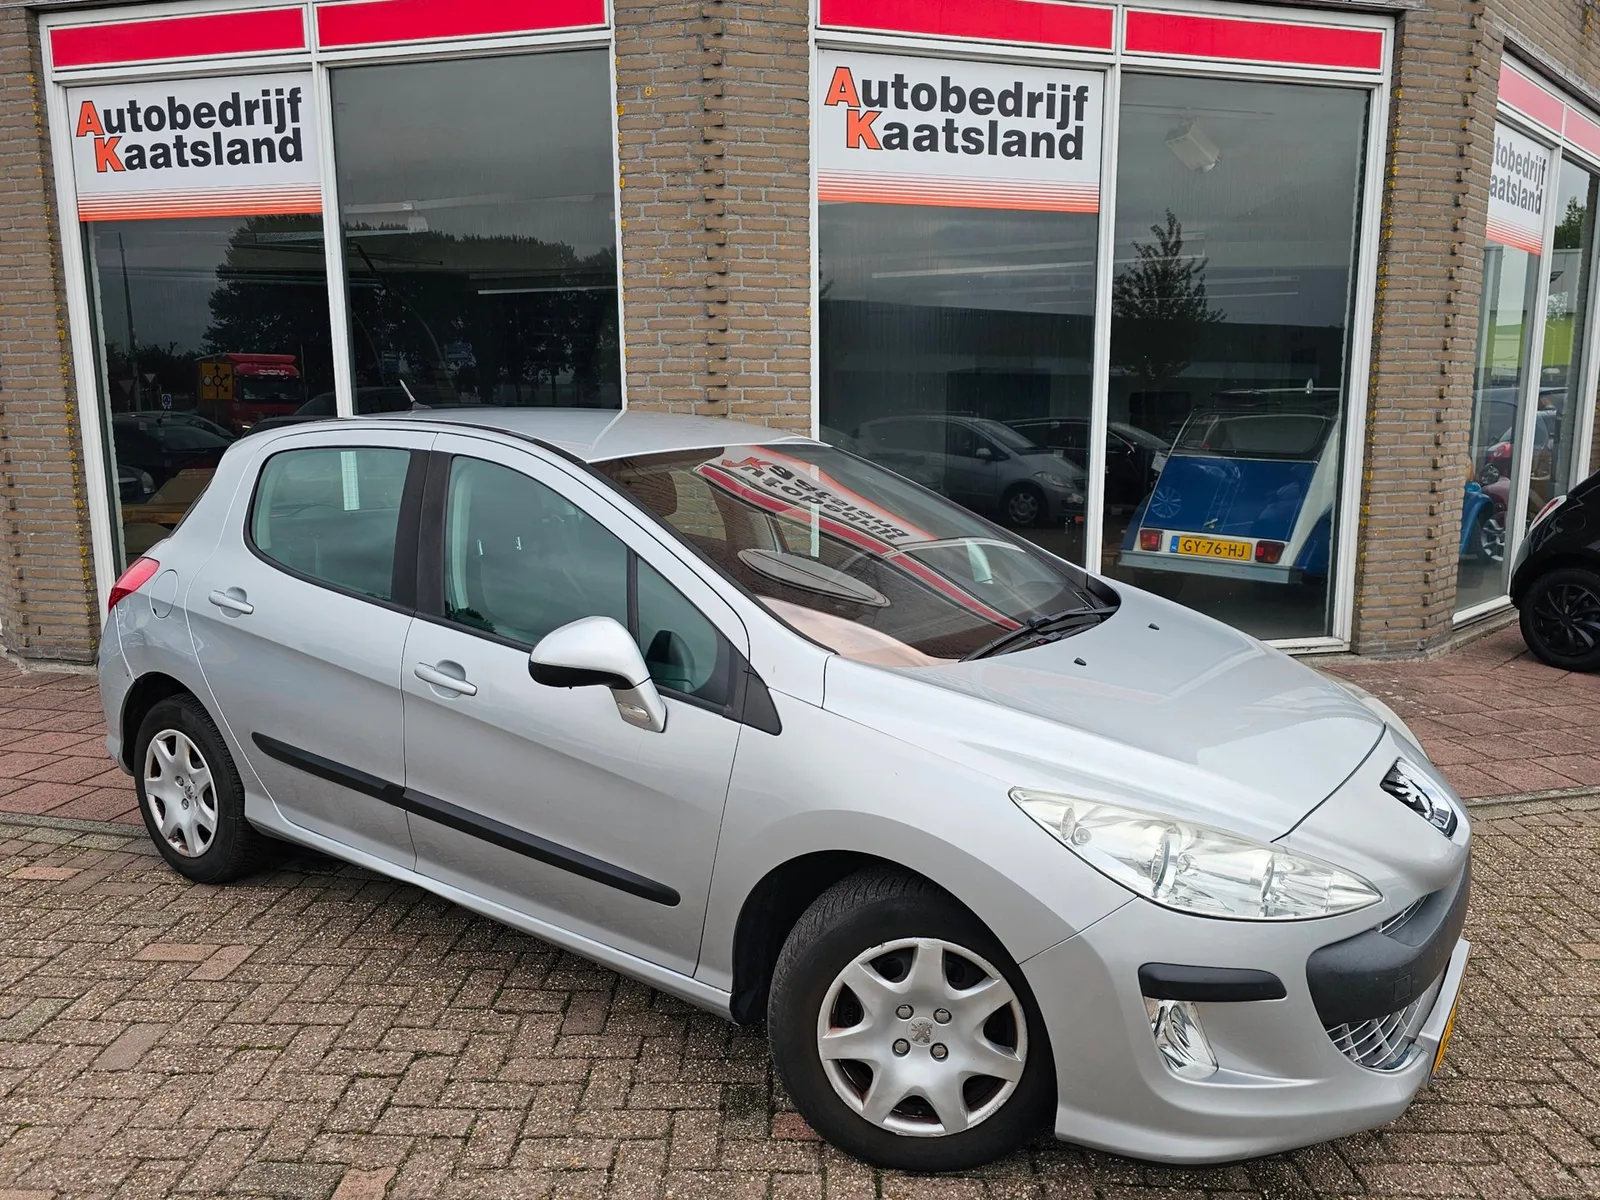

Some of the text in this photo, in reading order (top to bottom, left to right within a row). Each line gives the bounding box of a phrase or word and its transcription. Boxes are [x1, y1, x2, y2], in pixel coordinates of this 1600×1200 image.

[76, 87, 302, 137] Autobedrijf
[824, 66, 1089, 130] Autobedrijf
[94, 127, 303, 173] Kaatsland
[846, 109, 1084, 160] Kaatsland
[1494, 136, 1547, 191] tobedrijf
[1489, 174, 1543, 215] aatsland
[1182, 540, 1245, 557] GY-76-HJ
